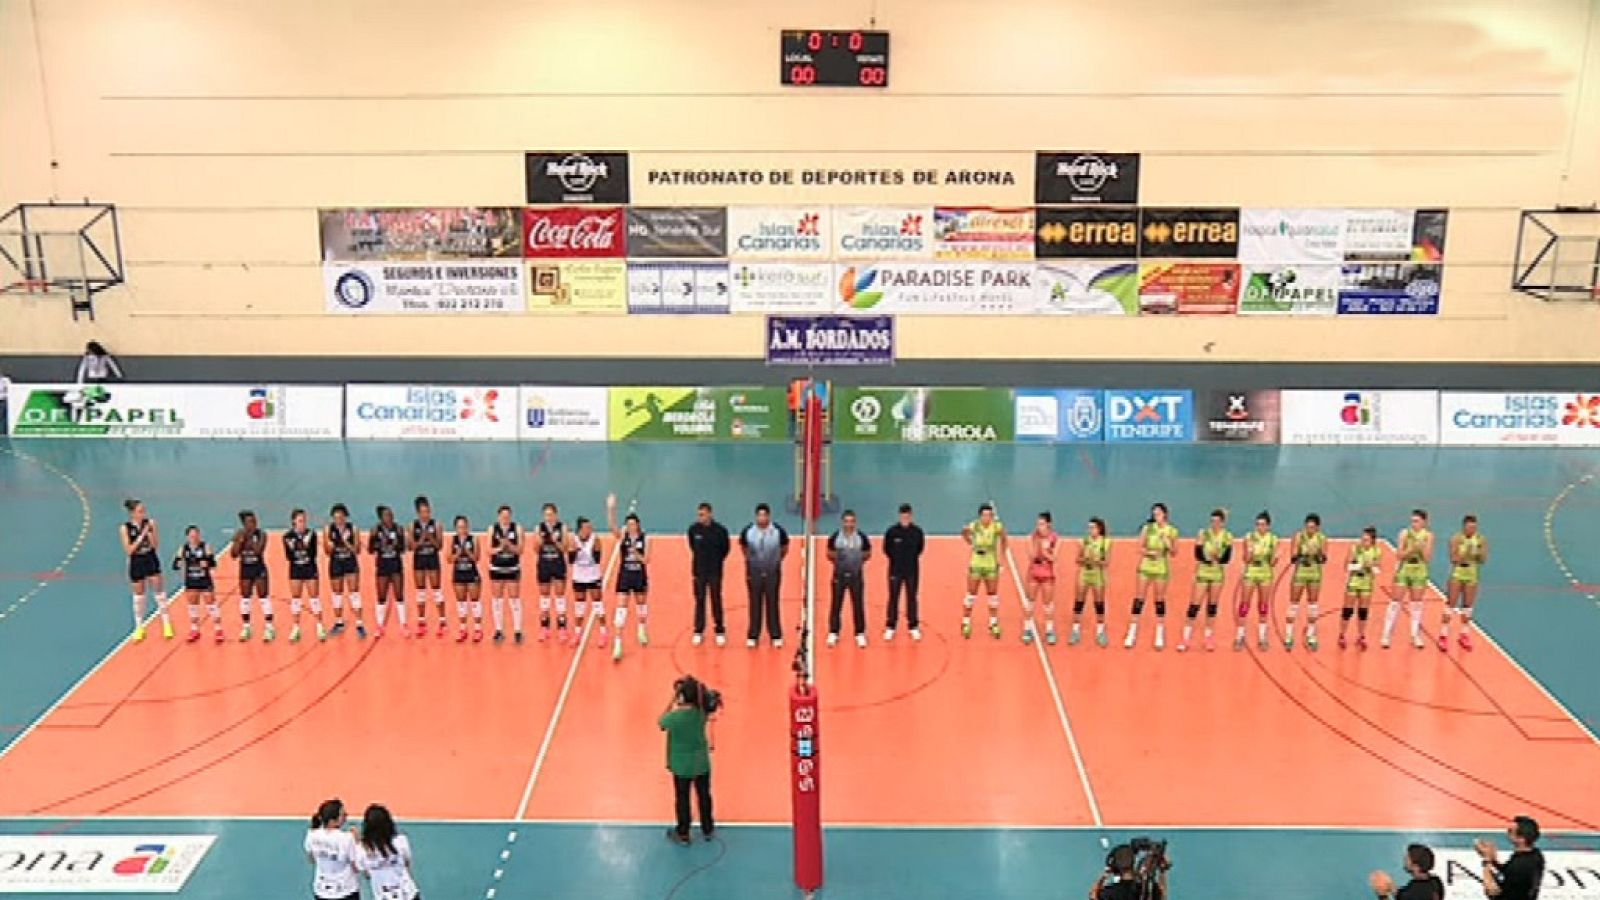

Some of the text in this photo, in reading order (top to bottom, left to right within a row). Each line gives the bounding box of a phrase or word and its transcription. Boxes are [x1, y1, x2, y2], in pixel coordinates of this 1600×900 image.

[808, 32, 822, 50] 0
[849, 32, 862, 51] 0
[860, 68, 885, 84] 00
[648, 169, 1016, 185] PATRONATO DE DEPORTES DE ARONA
[760, 222, 795, 236] Islas
[862, 222, 898, 236] Islas
[739, 235, 821, 251] Canarias
[841, 235, 924, 251] Canarias
[881, 269, 1032, 286] PARADISE PARK
[805, 329, 890, 350] BORDADOS
[407, 387, 458, 404] Islas
[1504, 395, 1558, 411] Islas
[357, 402, 457, 422] Canarias
[1110, 396, 1184, 422] DXT
[1453, 410, 1558, 429] Canarias
[1110, 424, 1184, 439] TENERIFE
